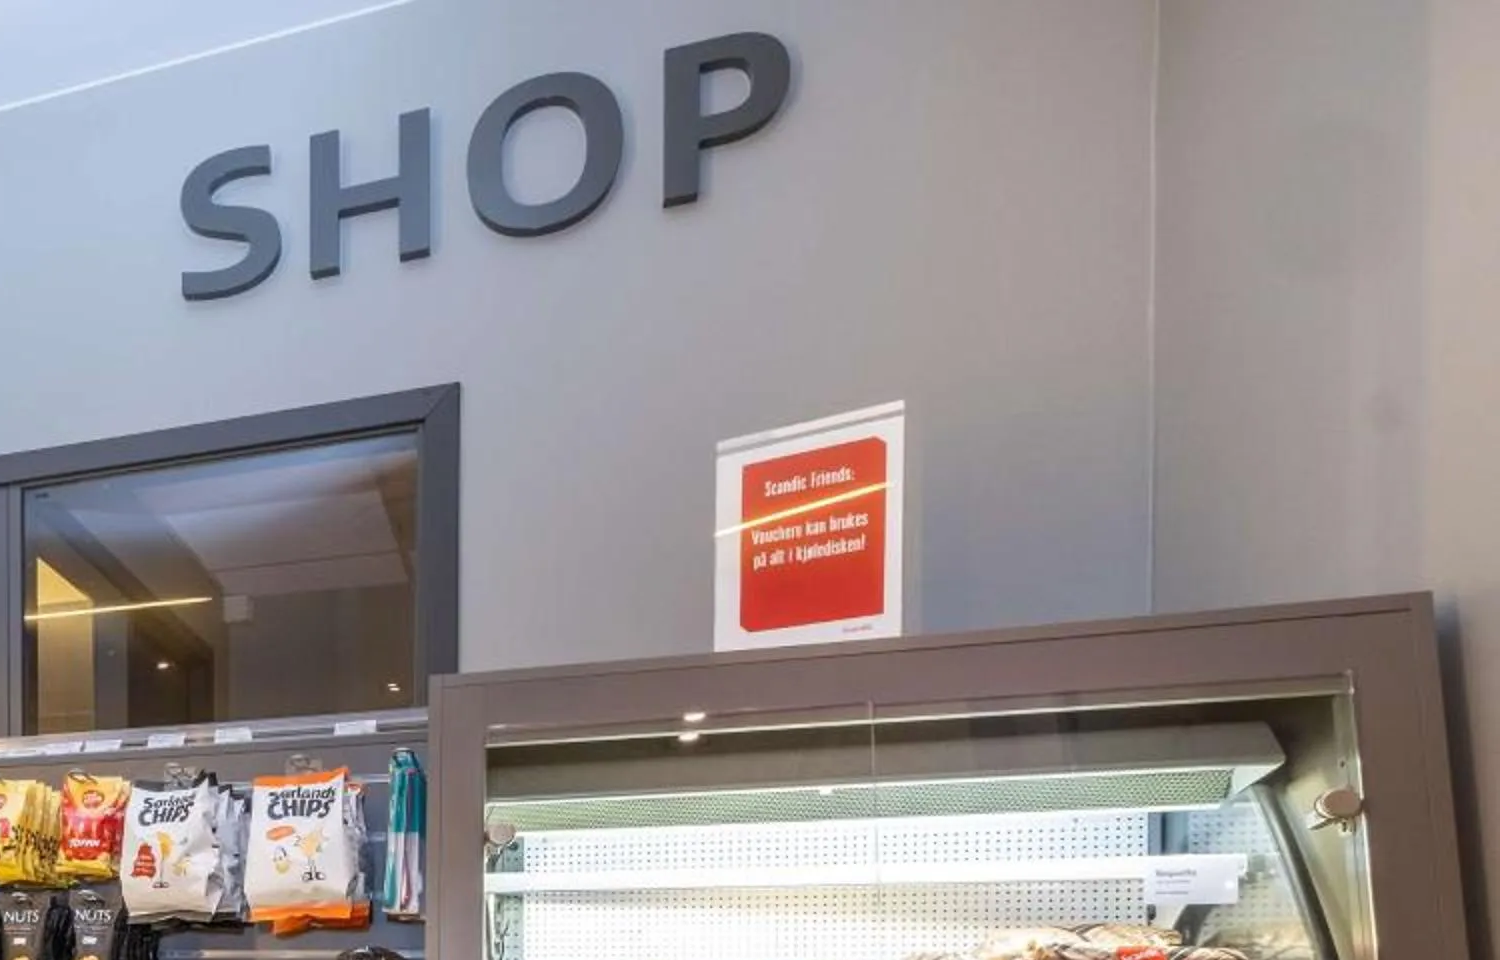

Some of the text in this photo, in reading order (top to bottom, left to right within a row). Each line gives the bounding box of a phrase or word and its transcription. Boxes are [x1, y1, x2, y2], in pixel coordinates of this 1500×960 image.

[180, 31, 791, 301] SHOP
[764, 467, 855, 497] Scandic Friends:
[805, 519, 827, 536] kan
[829, 512, 869, 531] brukes
[753, 553, 767, 571] på
[769, 549, 785, 566] alt
[138, 801, 195, 827] CHIPS
[267, 798, 336, 820] CHIPS
[3, 909, 40, 924] NUTS
[74, 908, 112, 923] NUTS
